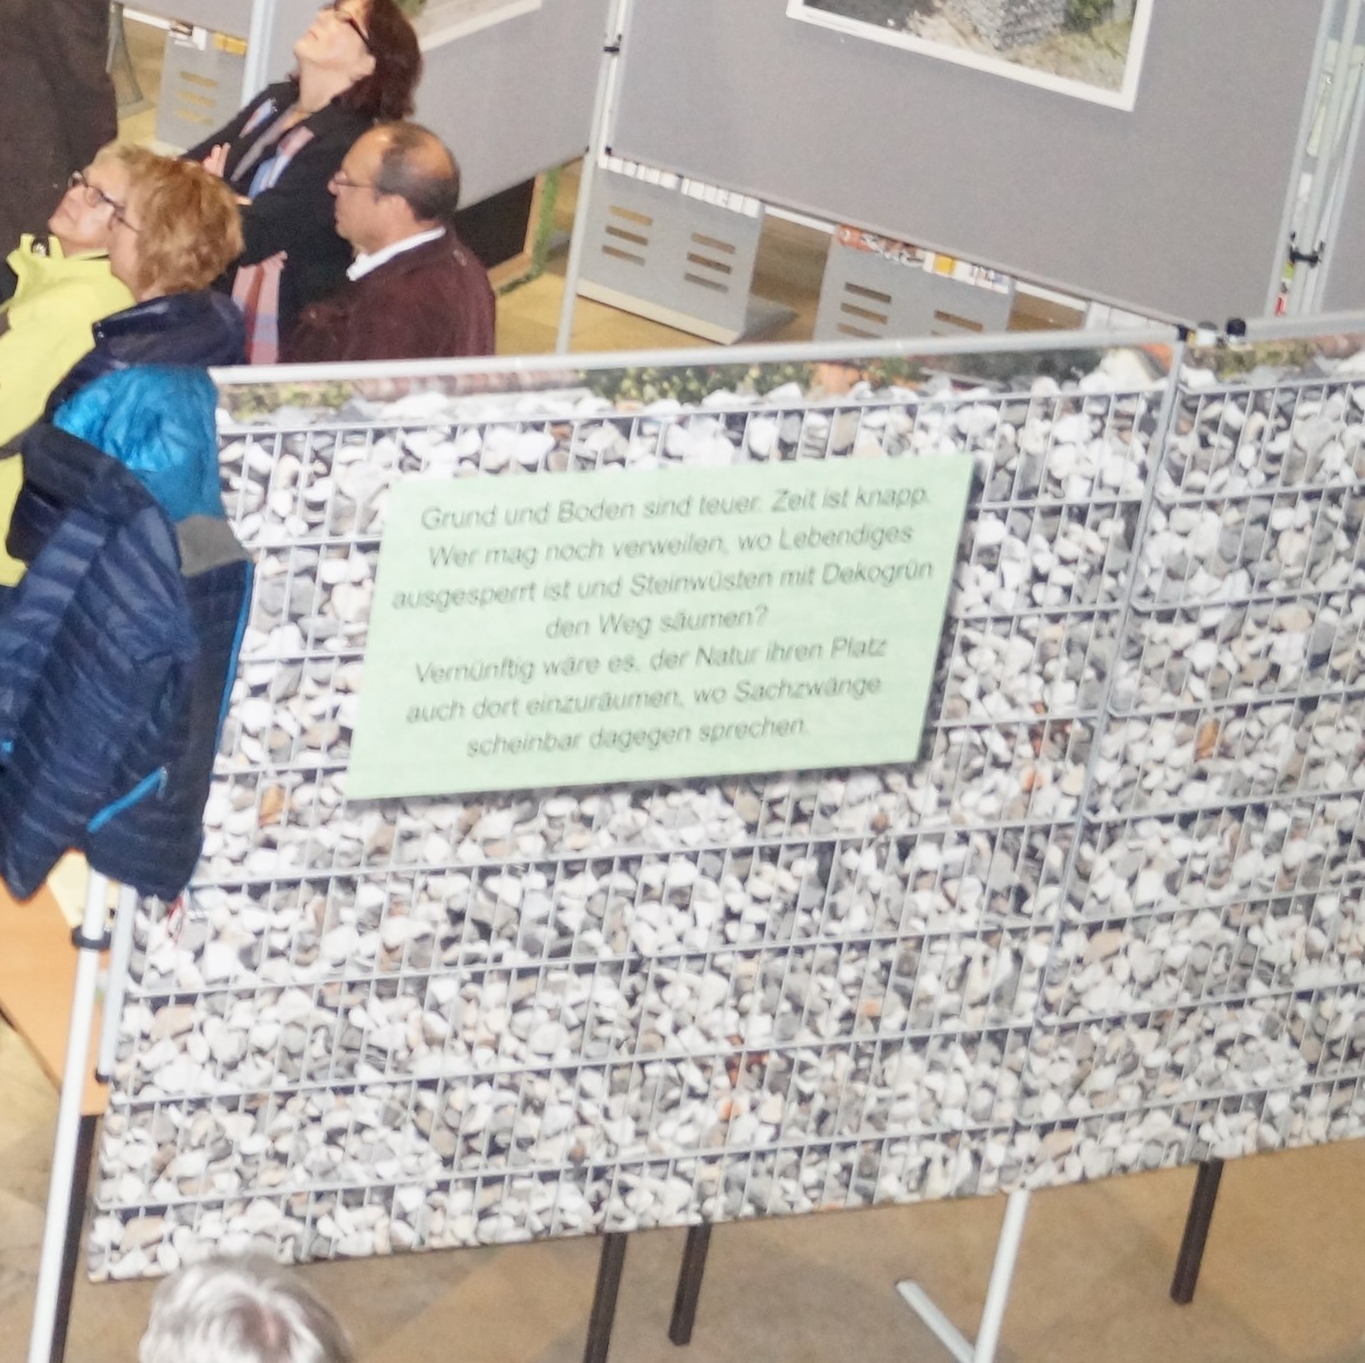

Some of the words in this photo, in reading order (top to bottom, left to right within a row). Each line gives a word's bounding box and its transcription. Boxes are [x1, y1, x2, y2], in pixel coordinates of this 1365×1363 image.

[421, 504, 497, 531] Grund
[504, 501, 551, 526] und
[558, 498, 635, 524] Boden
[643, 494, 693, 519] sind
[771, 487, 816, 513] Zeit
[822, 486, 849, 510] ist
[429, 544, 478, 567] Wer
[485, 544, 538, 570] mag
[545, 538, 604, 562] noch
[738, 531, 772, 552] wo
[779, 523, 914, 551] Lebendiges
[392, 580, 536, 612] ausgesperrt
[543, 577, 571, 602] ist
[577, 574, 623, 599] und
[629, 568, 773, 597] Steinwüsten
[780, 564, 815, 588] mit
[822, 559, 933, 587] Dekogrün
[545, 617, 590, 640] den
[599, 612, 652, 640] Weg
[660, 603, 768, 633] säumen?
[415, 656, 535, 684] Vernünftig
[543, 653, 601, 676] wäre
[650, 648, 690, 671] der
[695, 644, 758, 667] Natur
[765, 640, 823, 663] ihren
[830, 636, 887, 659] Platz
[406, 699, 465, 724] auch
[472, 697, 520, 719] dort
[694, 685, 727, 704] wo
[734, 676, 881, 702] Sachzwänge
[467, 730, 582, 758] scheinbar
[589, 723, 691, 752] dagegen
